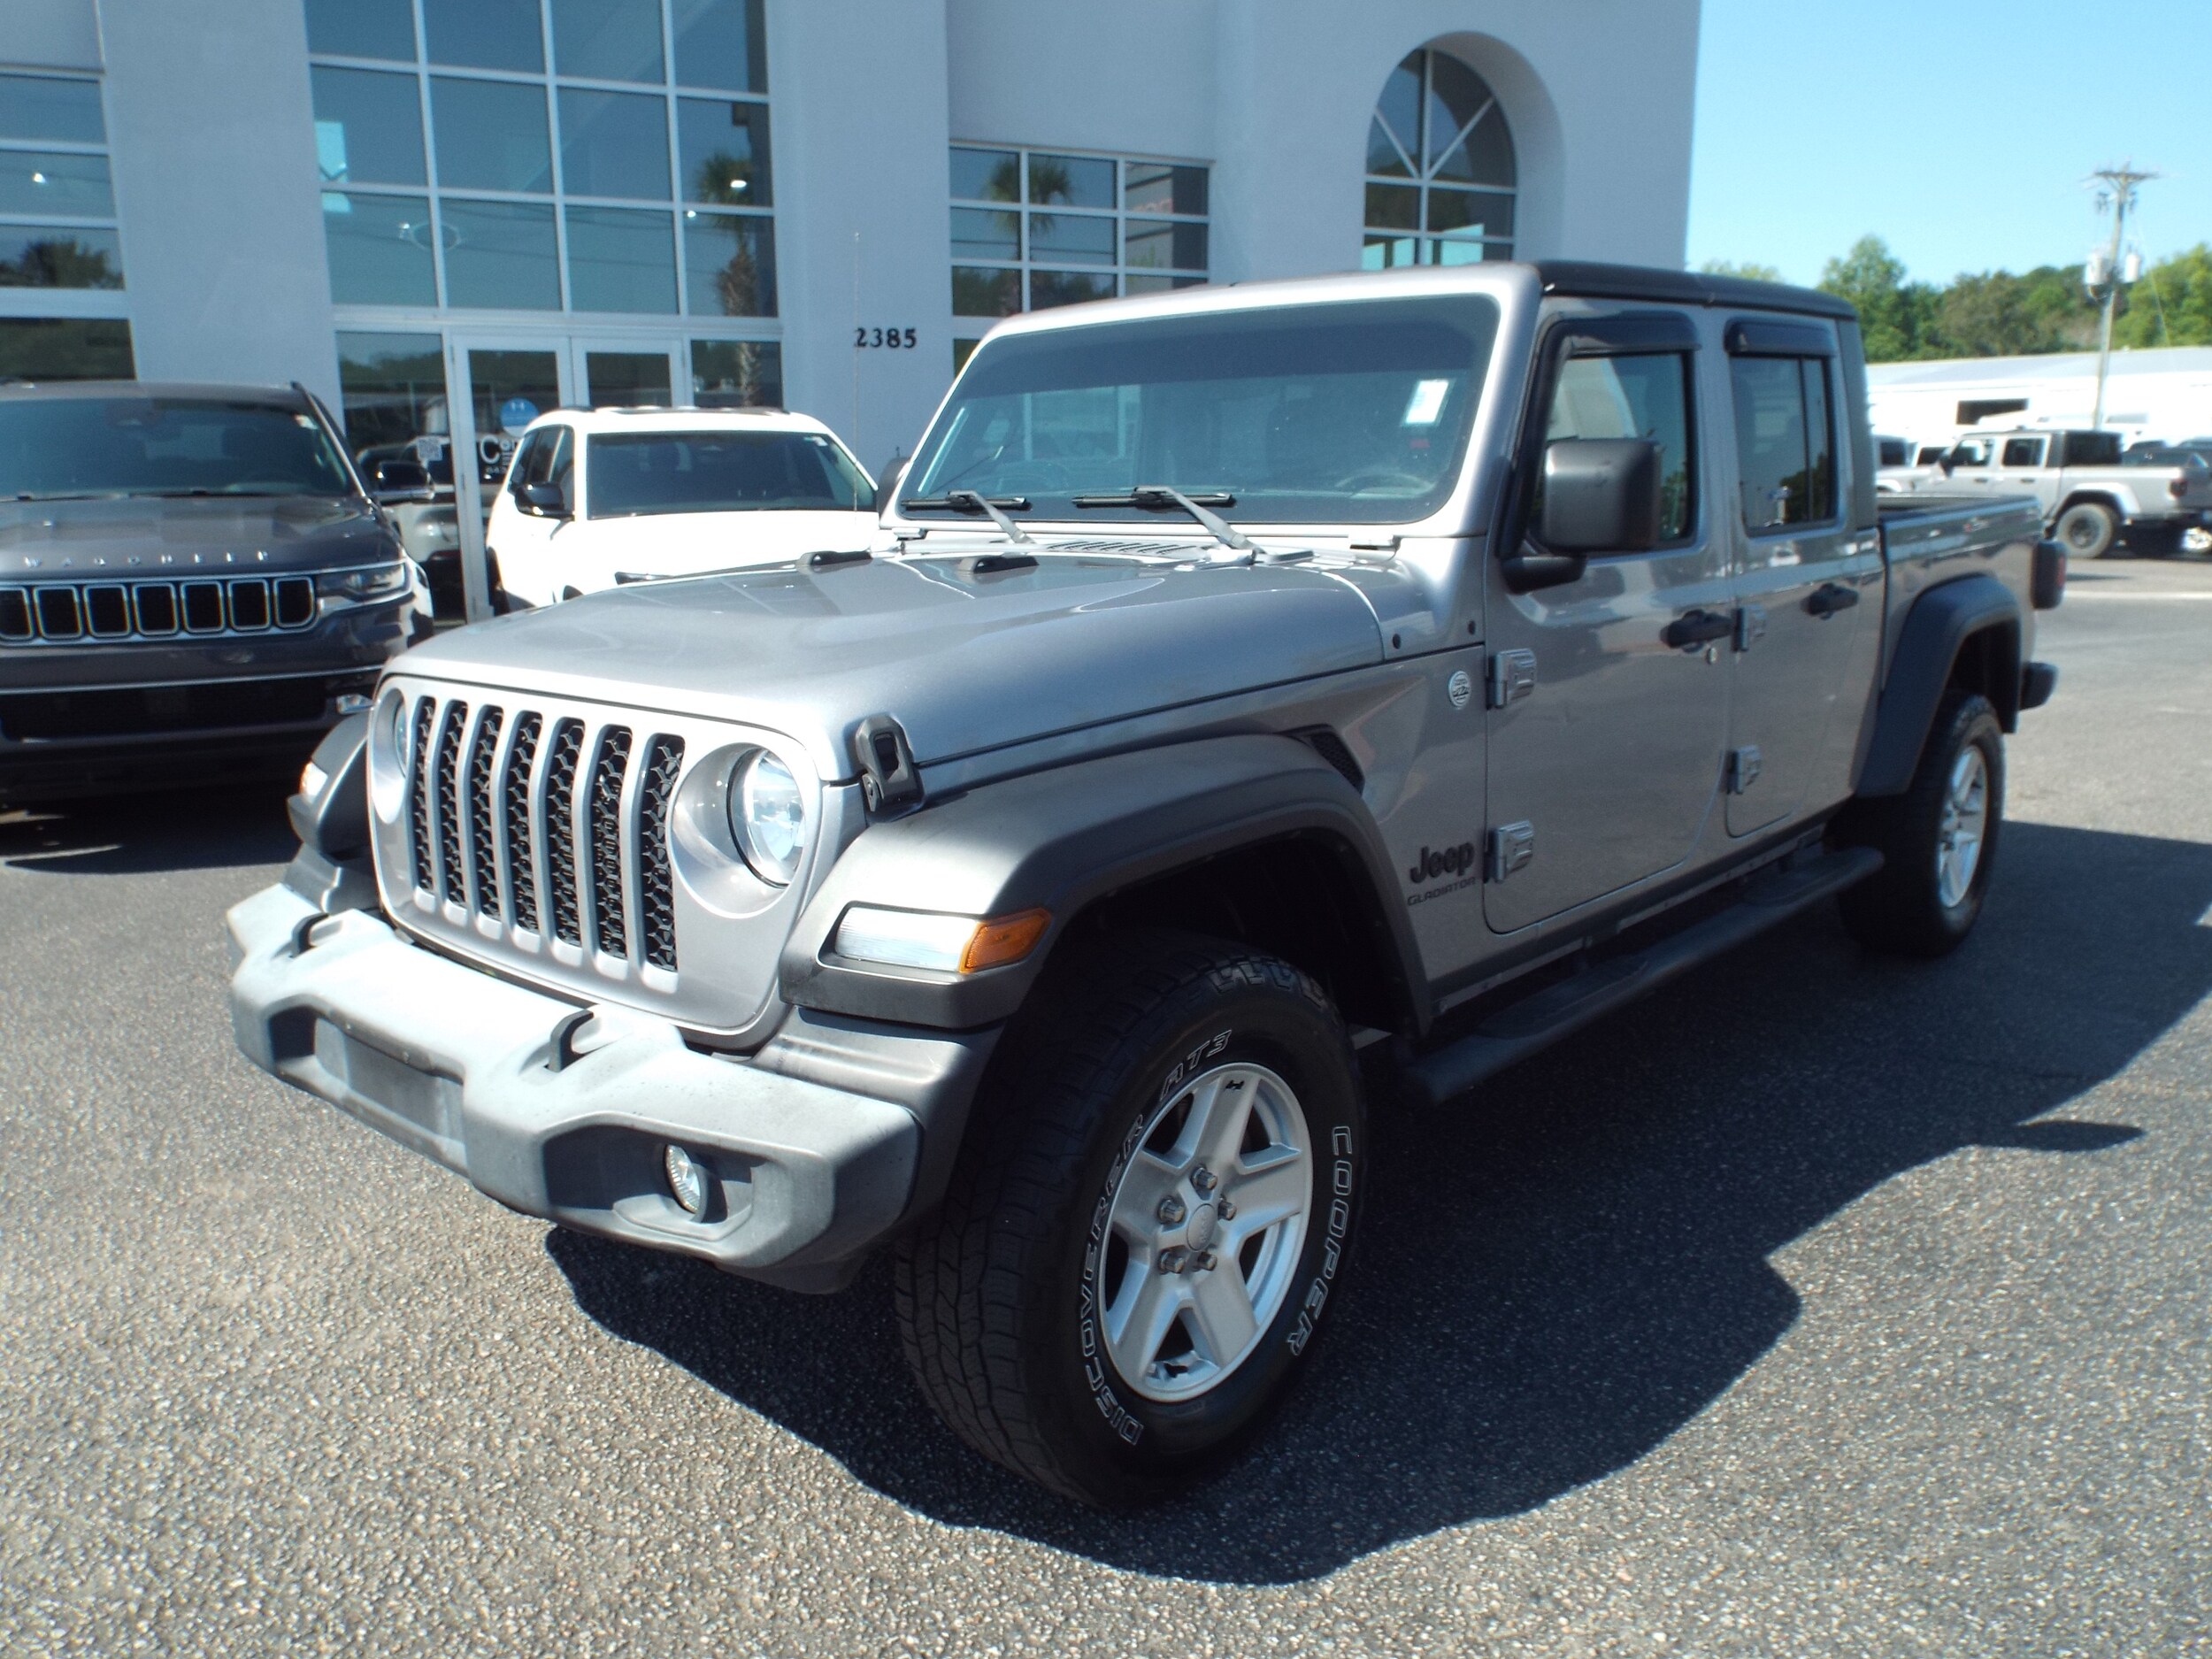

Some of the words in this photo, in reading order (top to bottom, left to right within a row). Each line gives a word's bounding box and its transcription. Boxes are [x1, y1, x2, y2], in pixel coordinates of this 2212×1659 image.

[854, 327, 917, 349] 2385
[1409, 841, 1475, 883] Jeep
[1407, 877, 1476, 907] GLADIATOR
[1079, 1113, 1145, 1446] DISCOVERER
[1159, 1029, 1233, 1102] AT3
[1286, 1125, 1353, 1356] COOPER
